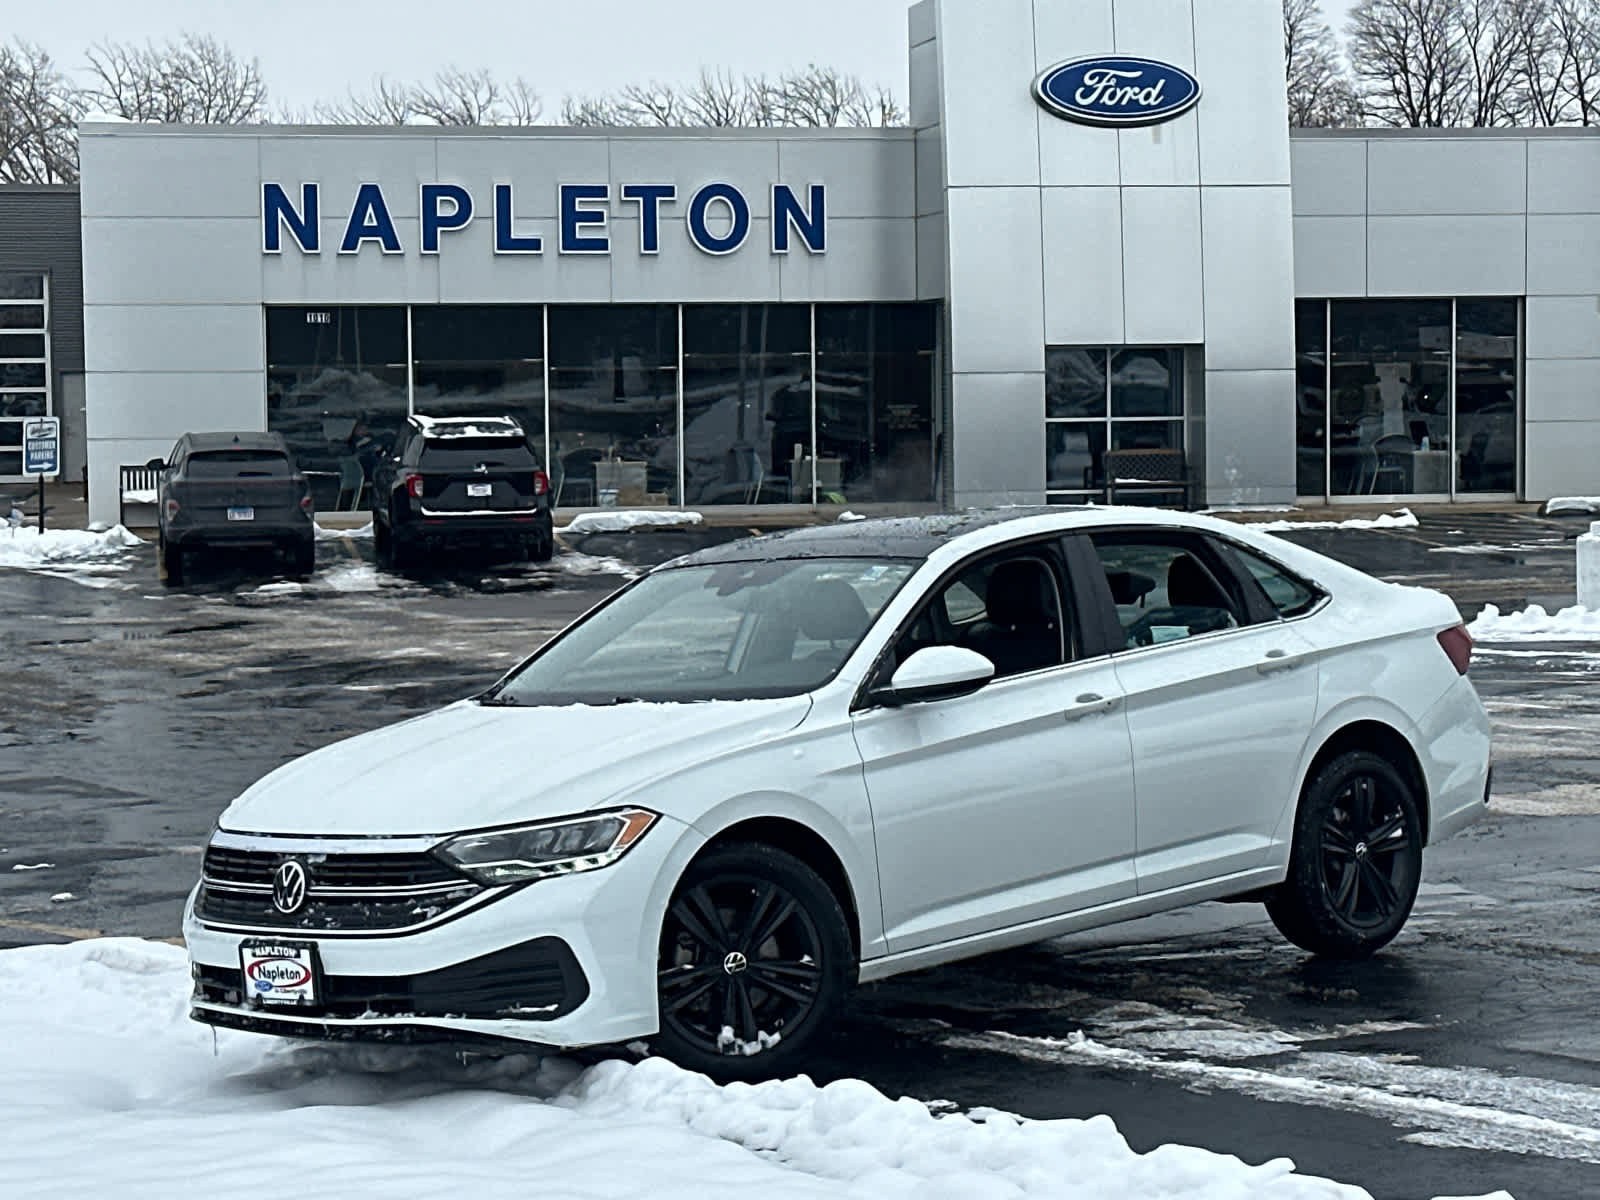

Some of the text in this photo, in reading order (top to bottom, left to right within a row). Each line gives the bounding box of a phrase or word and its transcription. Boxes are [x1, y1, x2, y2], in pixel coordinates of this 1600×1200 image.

[1074, 68, 1166, 106] Ford
[262, 182, 827, 255] NAPLETON
[257, 965, 302, 982] Napleton
